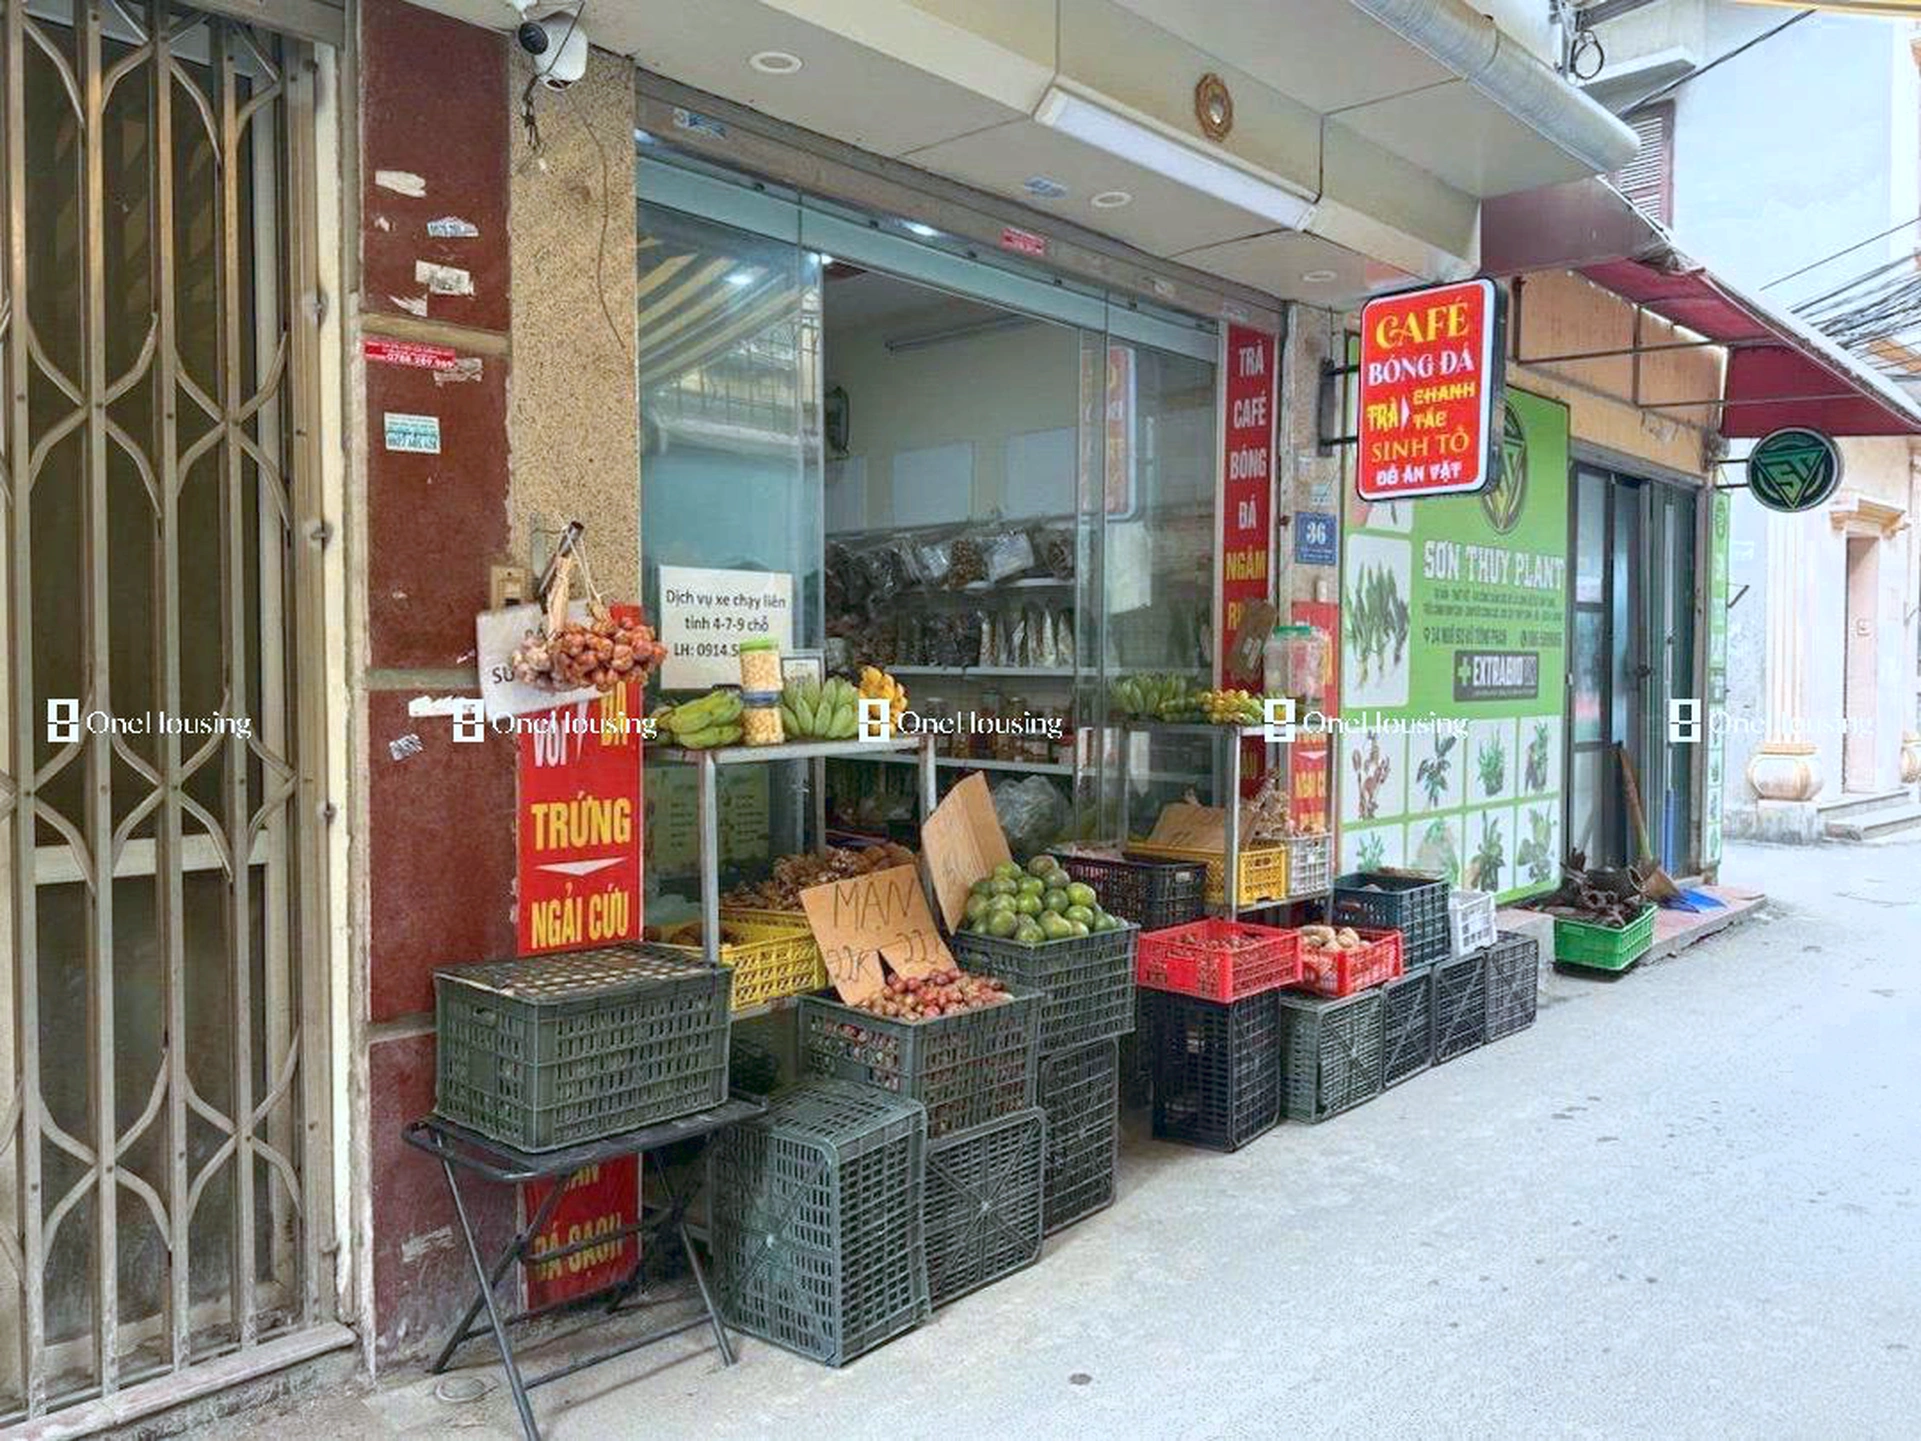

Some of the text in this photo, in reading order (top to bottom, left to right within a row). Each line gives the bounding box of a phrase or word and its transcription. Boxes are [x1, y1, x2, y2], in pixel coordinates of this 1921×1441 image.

[1368, 353, 1433, 386] BÓNG
[1233, 390, 1267, 429] CAFÉ
[1372, 437, 1428, 464] SINH
[1307, 522, 1326, 545] 36
[1514, 552, 1566, 590] PLANT
[666, 589, 694, 607] Dịch
[697, 594, 712, 608] vụ
[715, 595, 730, 606] xe
[733, 593, 761, 609] chạy
[713, 617, 744, 631] 4-7-9
[674, 643, 694, 656] LH:
[531, 791, 631, 851] TRỨNG
[588, 882, 630, 941] CỨU
